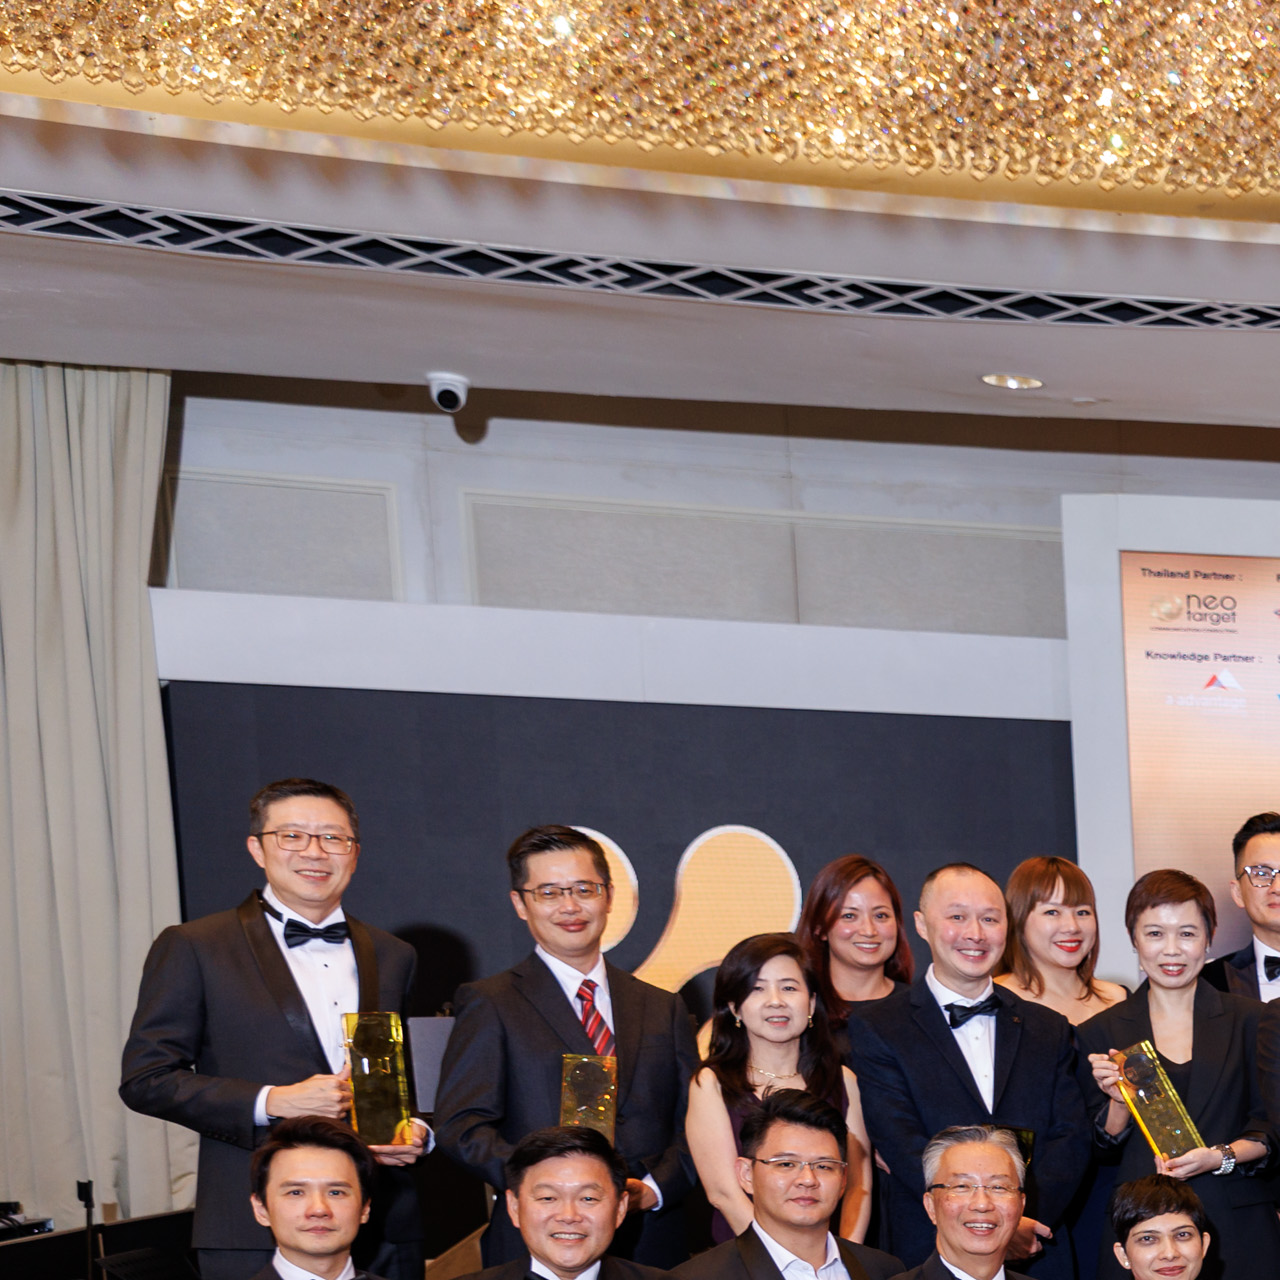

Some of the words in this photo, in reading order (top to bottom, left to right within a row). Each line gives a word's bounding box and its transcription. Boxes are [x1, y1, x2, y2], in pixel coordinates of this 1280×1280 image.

[1141, 567, 1190, 580] Thailand
[1193, 569, 1236, 582] Partner
[1186, 594, 1237, 610] neo
[1186, 610, 1236, 626] target
[1145, 650, 1210, 663] Knowledge
[1213, 653, 1255, 663] Partner
